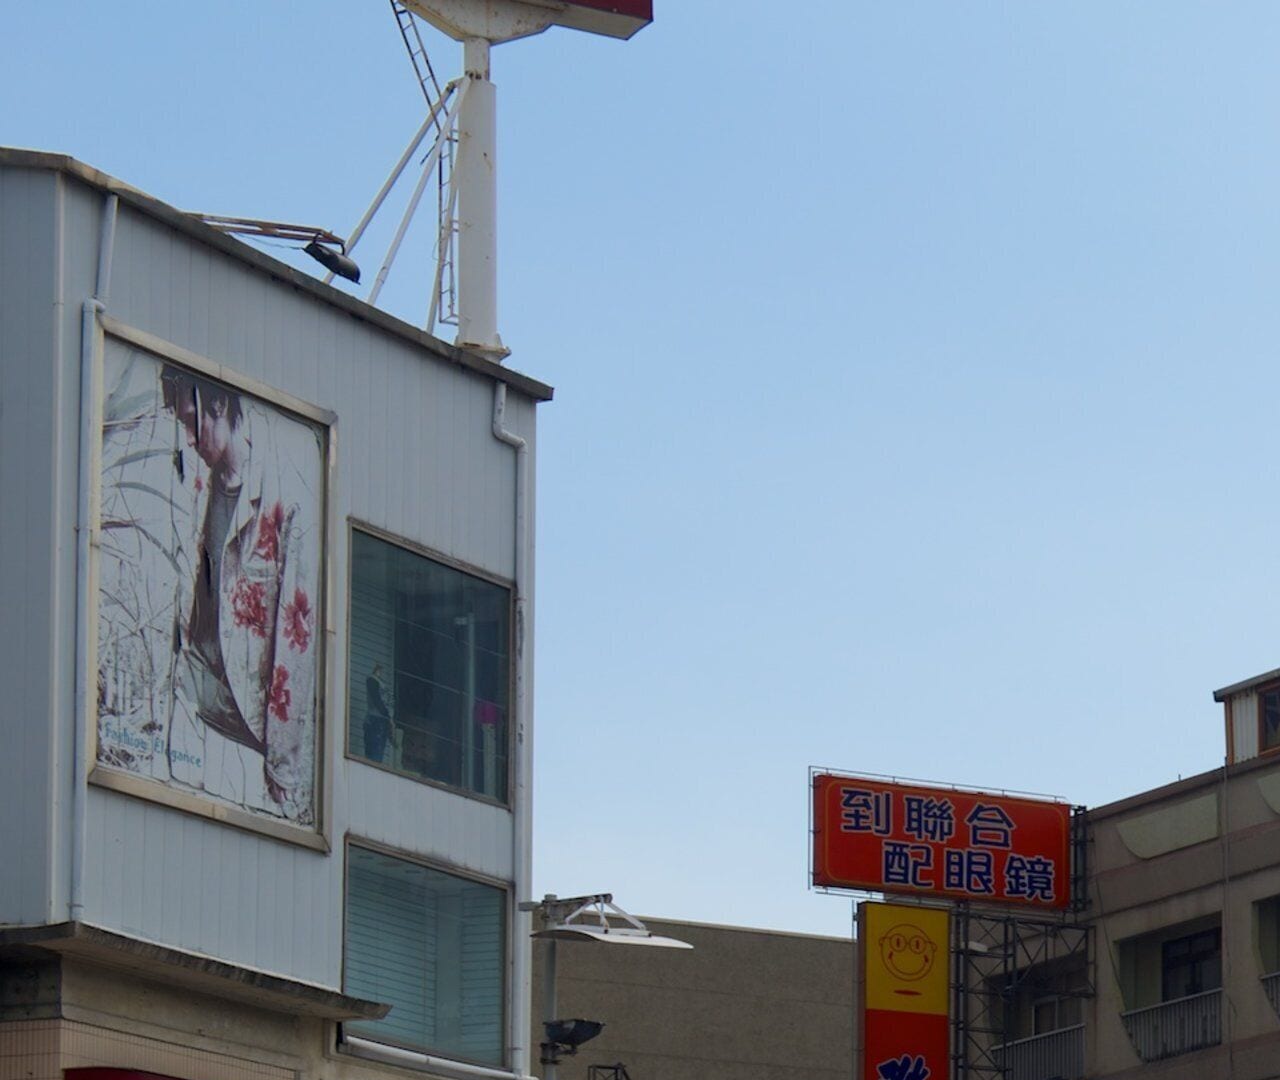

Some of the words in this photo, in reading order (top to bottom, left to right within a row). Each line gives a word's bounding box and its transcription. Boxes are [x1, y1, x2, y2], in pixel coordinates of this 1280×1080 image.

[841, 788, 1016, 849] 到聯合
[883, 844, 1056, 901] 配眼鏡
